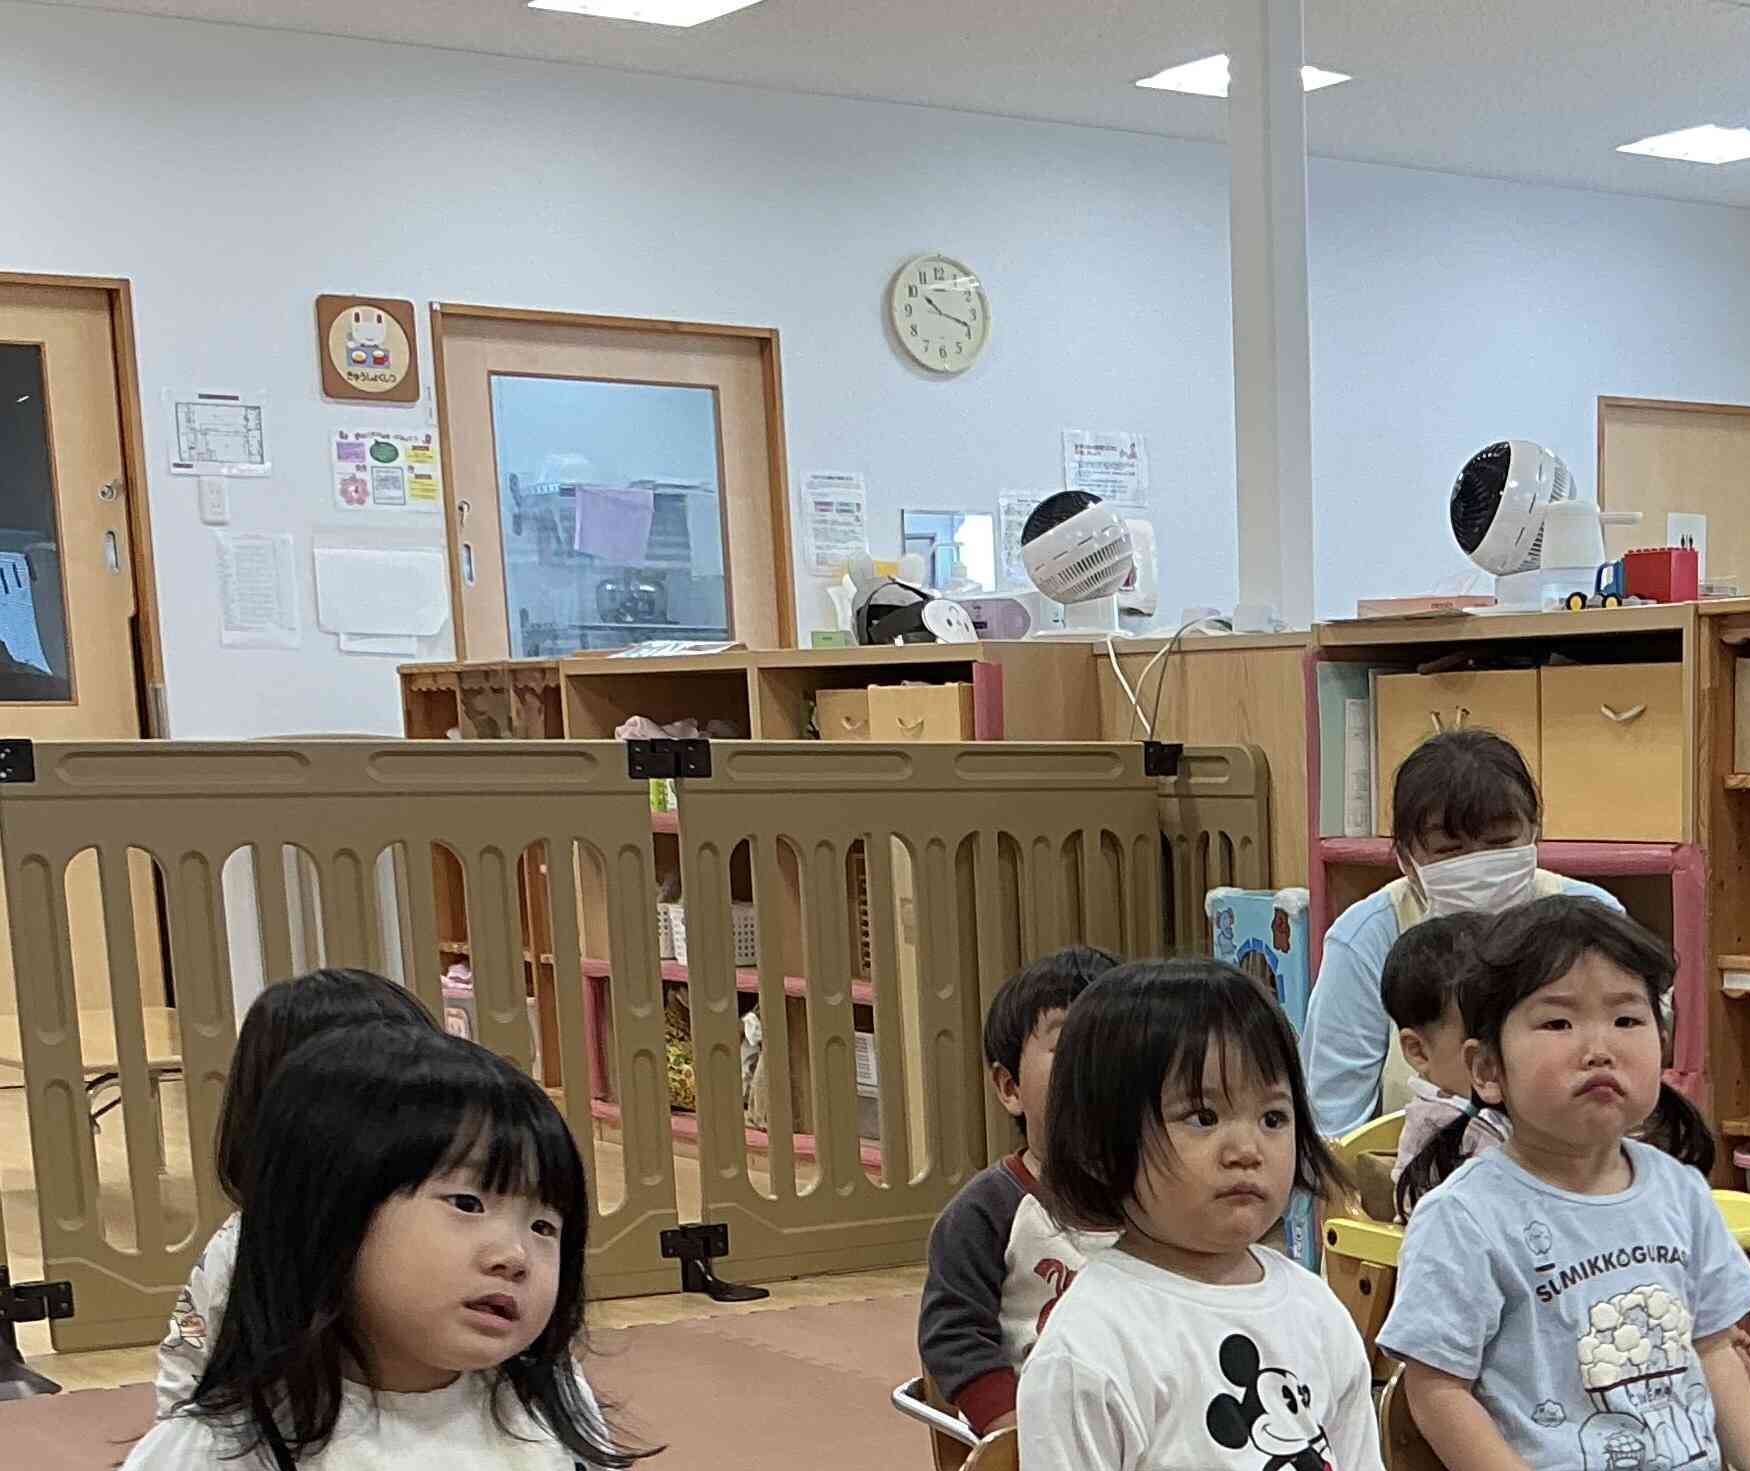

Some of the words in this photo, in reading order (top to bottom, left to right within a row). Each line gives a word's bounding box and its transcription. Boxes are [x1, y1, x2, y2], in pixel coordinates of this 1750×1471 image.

[918, 271, 927, 285] 11
[934, 267, 945, 281] 12
[908, 284, 918, 298] 10
[904, 303, 913, 318] 9
[969, 308, 977, 321] 3
[910, 323, 918, 337] 8
[922, 339, 930, 353] 7
[939, 345, 948, 359] 6
[955, 341, 963, 354] 5
